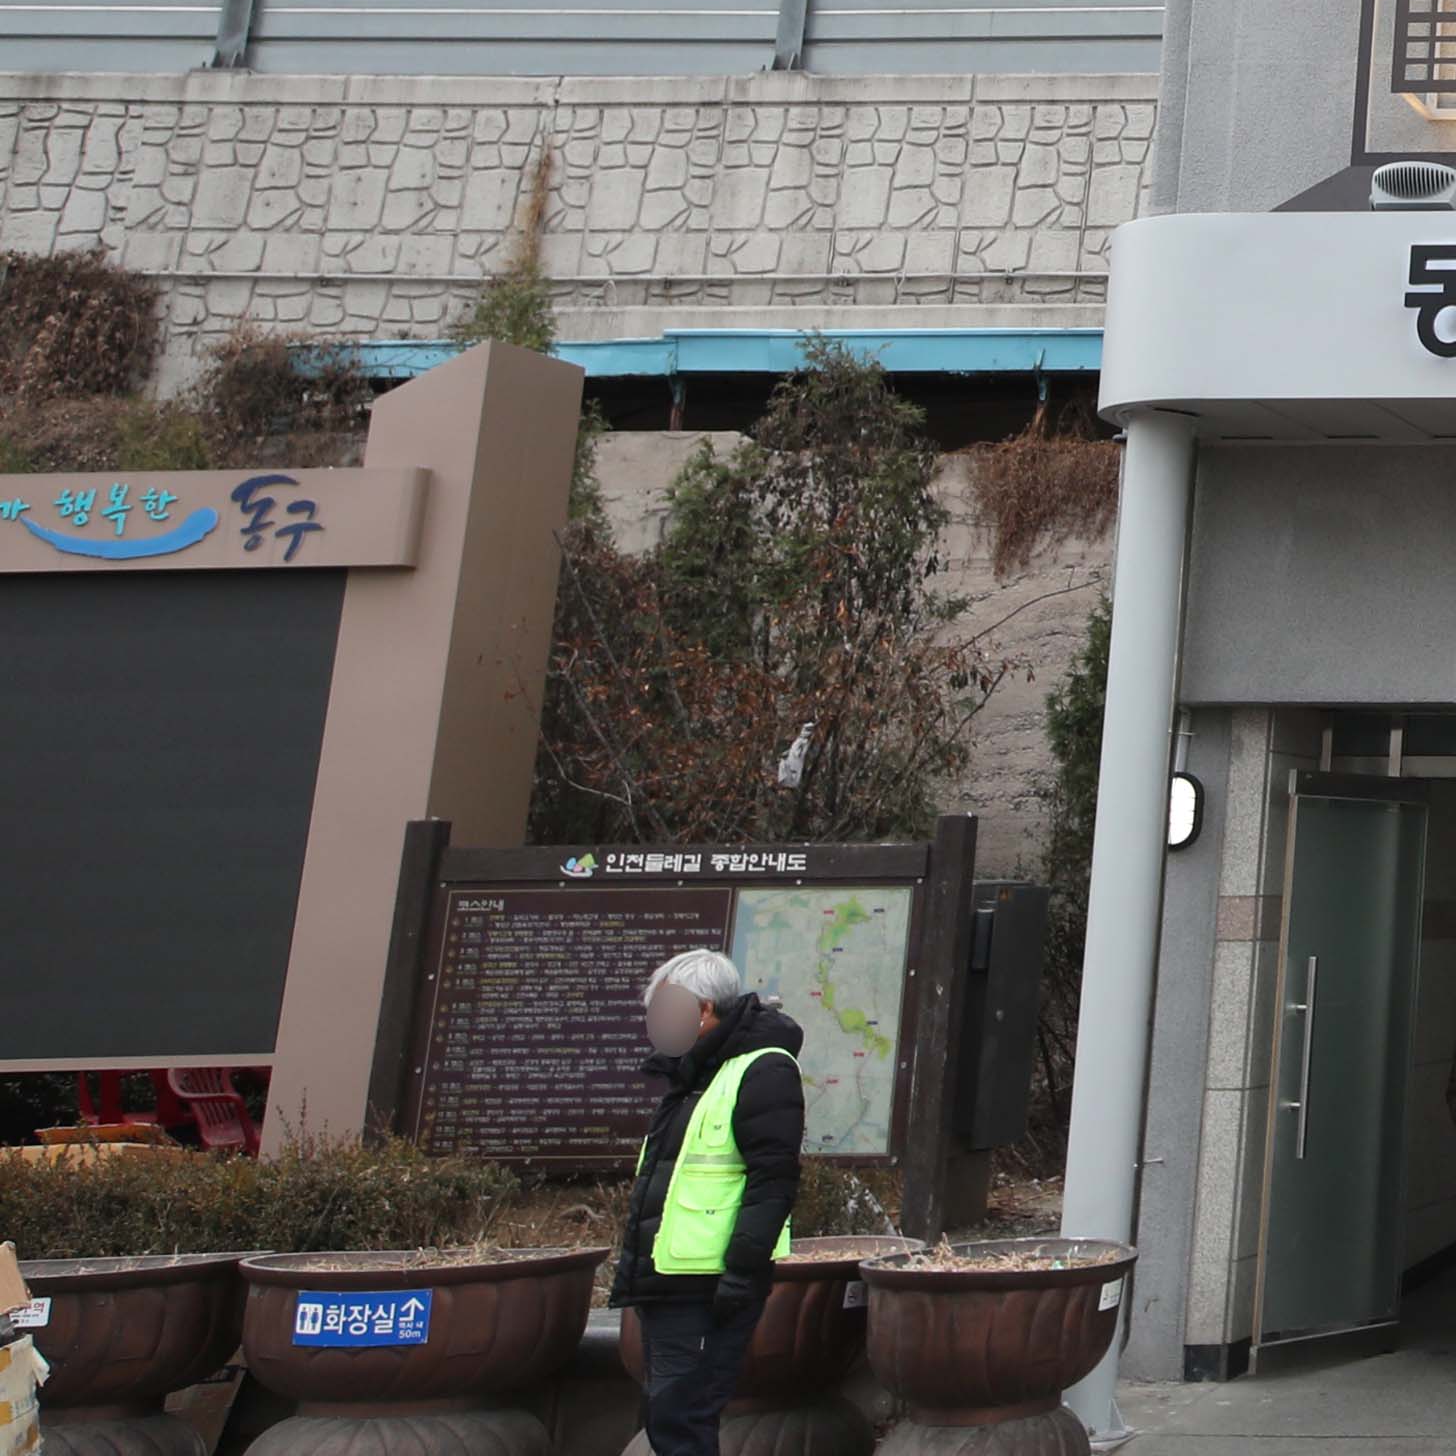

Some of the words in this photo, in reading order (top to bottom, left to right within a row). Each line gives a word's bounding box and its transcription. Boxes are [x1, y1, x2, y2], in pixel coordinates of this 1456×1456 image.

[53, 483, 179, 536] 행복한
[231, 474, 324, 561] 동구
[710, 852, 807, 872] 종합안내도
[323, 1304, 396, 1334] 화장실
[399, 1330, 421, 1339] 50m
